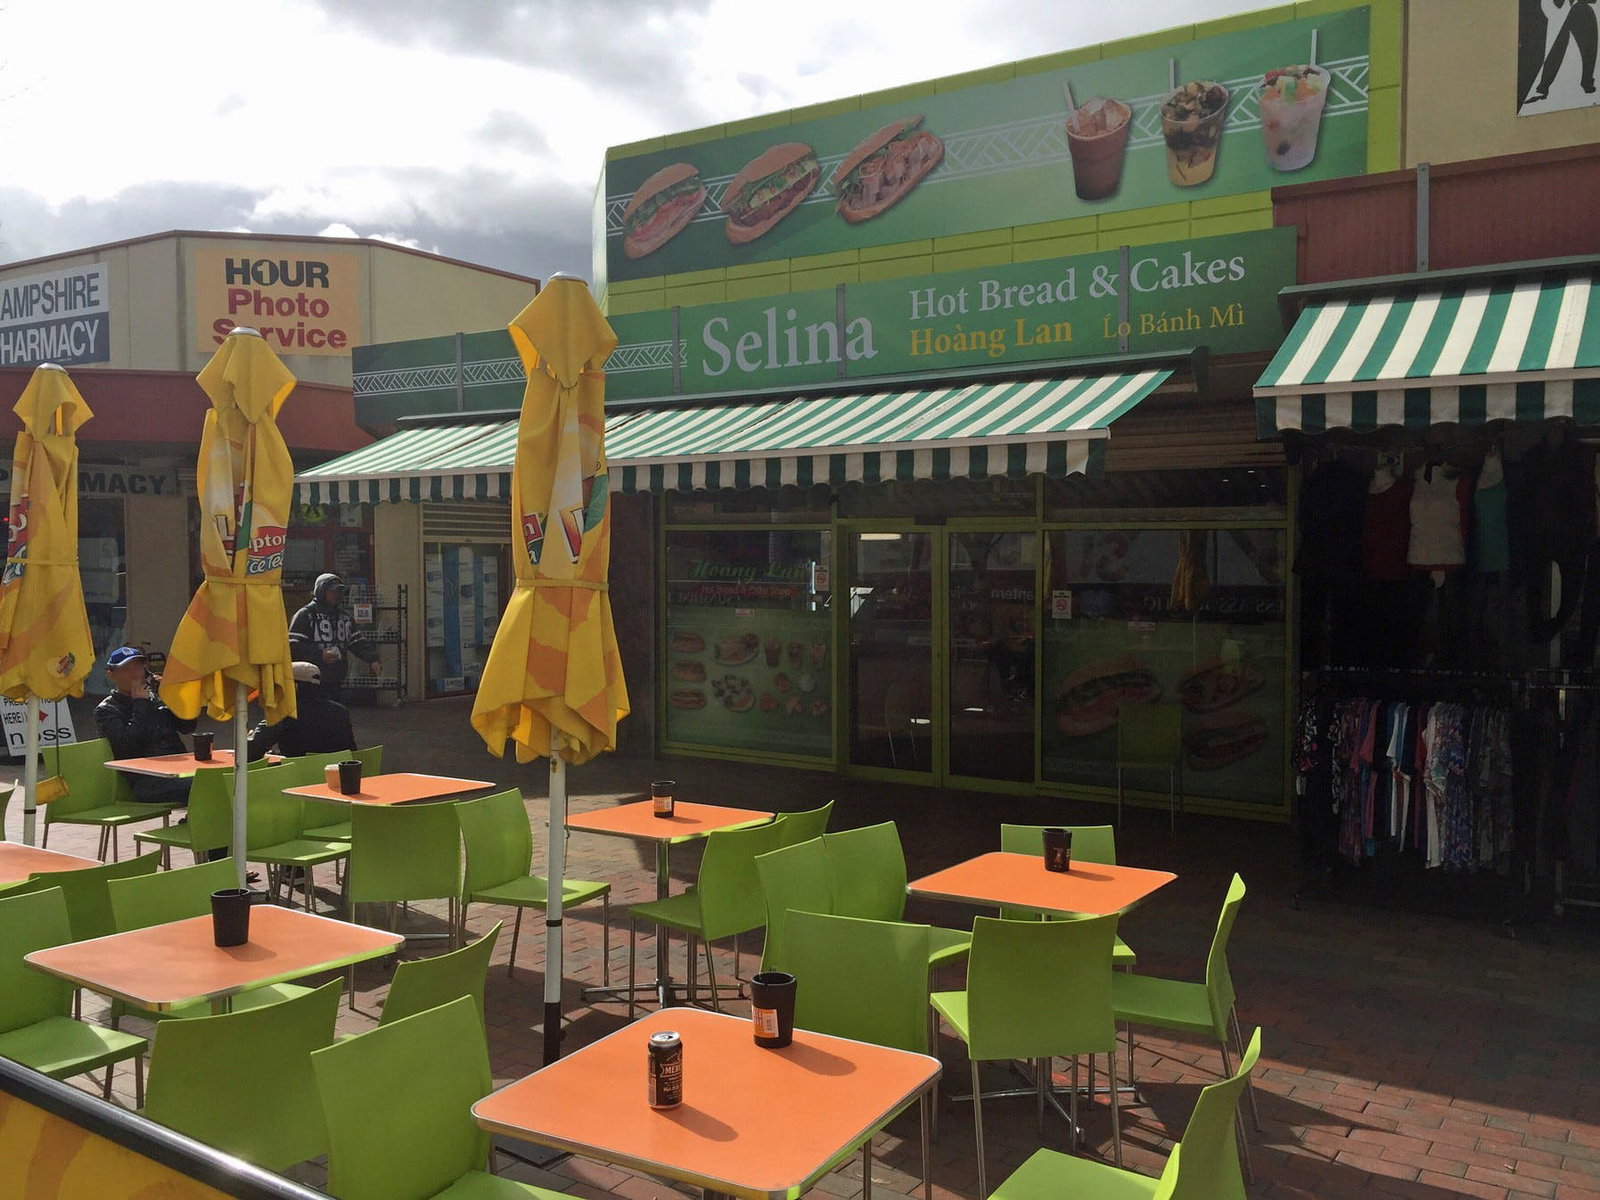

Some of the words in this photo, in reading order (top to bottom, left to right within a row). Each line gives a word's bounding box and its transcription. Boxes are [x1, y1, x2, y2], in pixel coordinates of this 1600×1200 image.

[1, 272, 100, 320] AMPSHIRE
[228, 288, 329, 318] Photo
[909, 287, 969, 320] Hot
[978, 267, 1077, 312] Bread
[1089, 265, 1119, 298] &
[1130, 251, 1246, 292] Cakes
[212, 318, 348, 349] Srvice
[908, 324, 1007, 358] Hoàng
[1015, 318, 1074, 347] Lan
[1139, 308, 1202, 335] Bánh
[1210, 303, 1246, 329] Mì
[0, 320, 99, 364] HARMACY
[702, 307, 878, 378] Selina
[9, 726, 72, 746] nss
